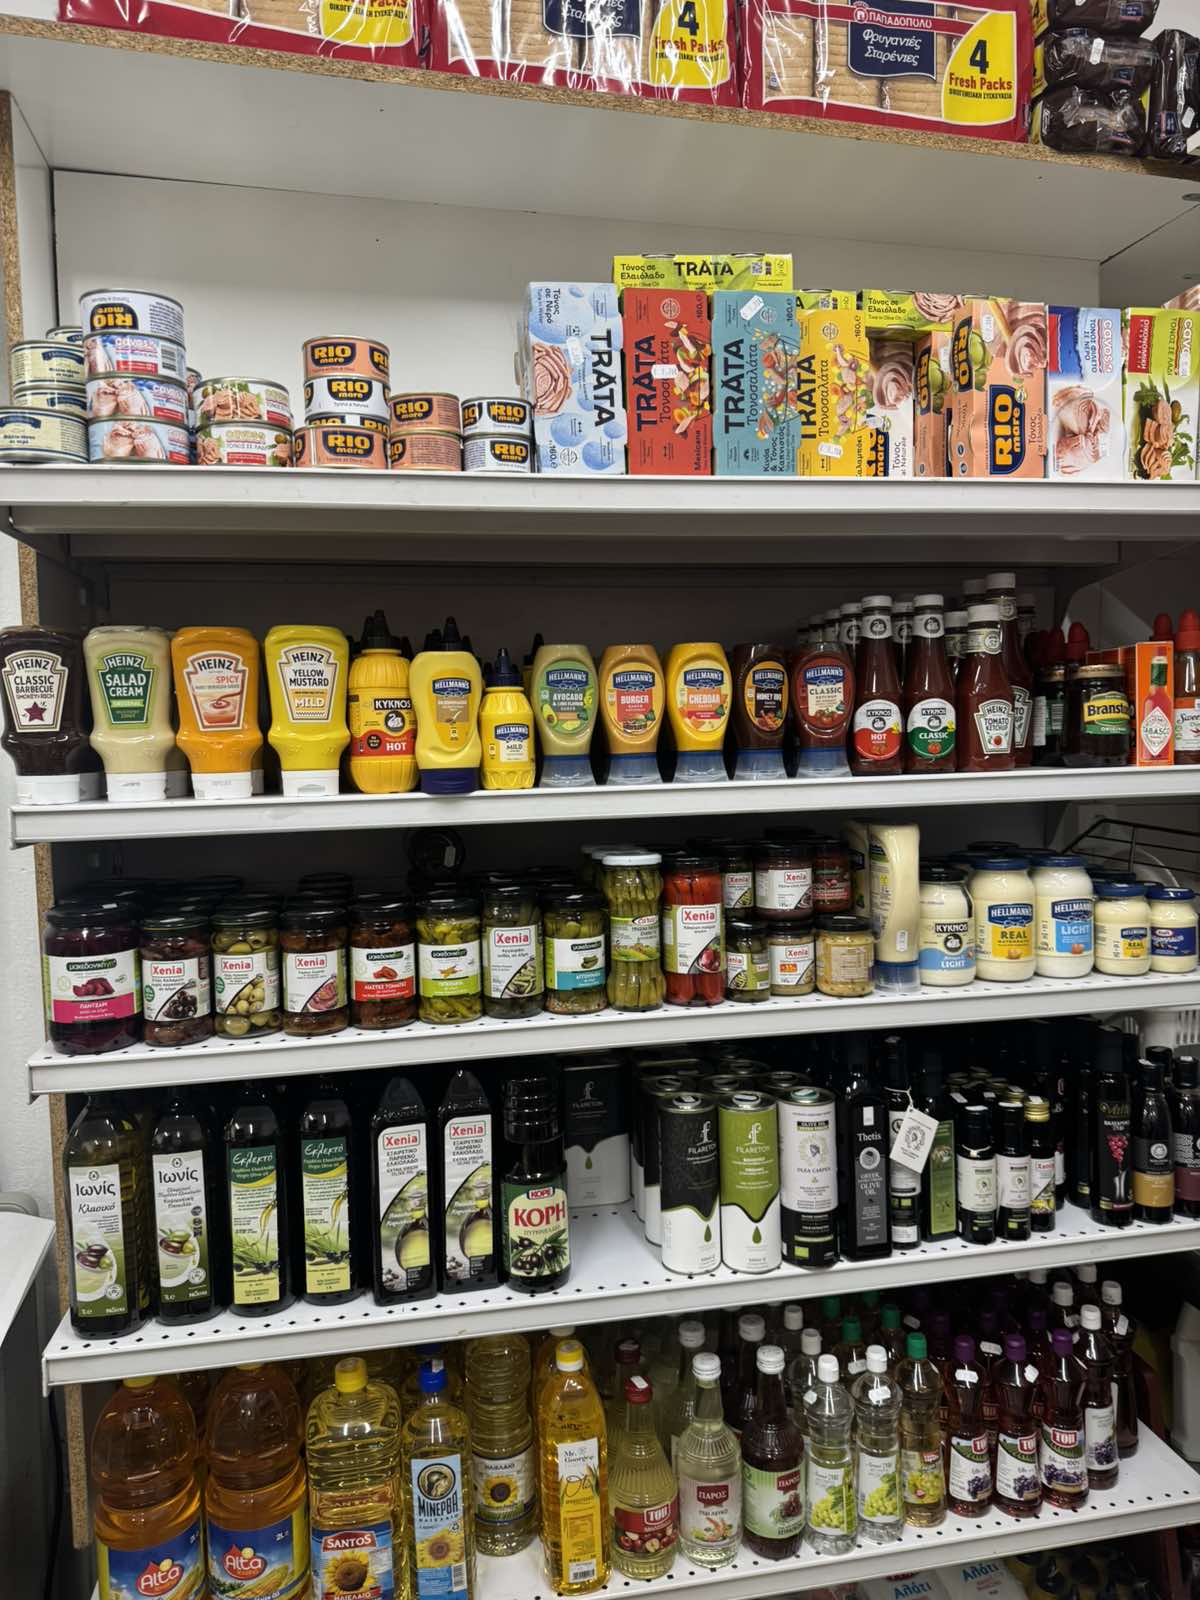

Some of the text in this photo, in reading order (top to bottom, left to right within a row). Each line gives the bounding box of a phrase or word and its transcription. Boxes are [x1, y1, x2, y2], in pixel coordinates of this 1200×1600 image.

[678, 2, 699, 36] 4
[863, 29, 922, 50] Φρυγανιές
[690, 40, 725, 53] Packs
[864, 46, 919, 66] Σταρένιες
[970, 40, 989, 74] 4
[949, 73, 1012, 90] Fresh Packs
[620, 264, 645, 273] Τόνος
[621, 272, 665, 280] Ελαιόλαδο
[544, 288, 552, 299] σε
[552, 288, 561, 315] Τόνος
[868, 298, 889, 307] Τόνος
[868, 306, 907, 314] Ελαιόλαδο
[94, 314, 133, 328] RIO
[314, 345, 351, 359] RIO
[958, 327, 970, 385] RIO
[332, 380, 369, 394] RIO
[746, 344, 759, 425] Τονοσαλάτα
[818, 360, 830, 437] Τονοσαλάτα
[396, 402, 429, 415] RIO
[490, 405, 523, 418] RIO
[995, 394, 1013, 466] RIO
[1013, 408, 1022, 453] mare
[1028, 416, 1037, 444] Τόνος
[328, 434, 370, 448] RIO
[495, 444, 526, 457] RIO
[770, 437, 778, 461] Τόνος
[108, 656, 142, 667] HEINZ
[292, 652, 325, 663] HEINZ
[16, 658, 50, 671] HEINZ
[198, 658, 233, 671] HEINZ
[292, 669, 324, 677] YELLOW
[549, 672, 586, 682] HELLMANN'S
[686, 672, 722, 681] HELLMANN'S
[806, 668, 844, 679] HELLMANN'S
[14, 675, 55, 685] CLASSIC
[106, 674, 147, 686] SALAD
[216, 676, 239, 684] SPICY
[290, 677, 329, 687] MUSTARD
[435, 680, 470, 689] HELLMANN'S
[616, 674, 653, 684] HELLMANN'S
[16, 686, 54, 694] BARBECUE
[110, 687, 144, 697] CREAM
[810, 687, 842, 696] CLASSIC
[296, 698, 325, 708] MILD
[620, 695, 649, 705] BURGER
[689, 694, 721, 704] CHEDDAR
[375, 700, 411, 710] KYKNOS
[986, 705, 1007, 714] HEINZ
[984, 718, 1009, 726] TOMATO
[496, 726, 529, 735] HELLMANN'S
[986, 724, 1008, 732] KETCHUP
[919, 732, 949, 740] CLASSIC
[386, 742, 407, 751] HOT
[684, 909, 715, 921] Xenia
[936, 923, 968, 932] KYKNOS
[1062, 926, 1090, 935] LIGHT
[496, 933, 529, 944] Xenia
[1000, 930, 1027, 939] REAL
[223, 962, 251, 970] Xenia
[297, 958, 325, 967] Xenia
[942, 960, 966, 969] LIGHT
[152, 966, 183, 975] Xenia
[452, 1125, 484, 1137] Xenia
[856, 1132, 882, 1141] Thetis
[386, 1134, 418, 1146] Xenia
[304, 1142, 344, 1160] Εκλεκτό
[232, 1152, 273, 1167] Εκλεκτό
[159, 1169, 199, 1184] Ιωνίς
[76, 1182, 116, 1196] Ιωνίς
[78, 1203, 116, 1214] Κλασικό
[514, 1202, 566, 1228] ΚΟΡΗ
[698, 1490, 727, 1500] ΠΑΡΟΣ
[418, 1490, 458, 1517] ΜΙΝΕΡΒΑ
[328, 1535, 372, 1549] SANTOS
[226, 1555, 263, 1571] Alta
[962, 1562, 1000, 1581] Αλάτι
[141, 1566, 180, 1589] Alta
[894, 1581, 932, 1600] Αλάτι
